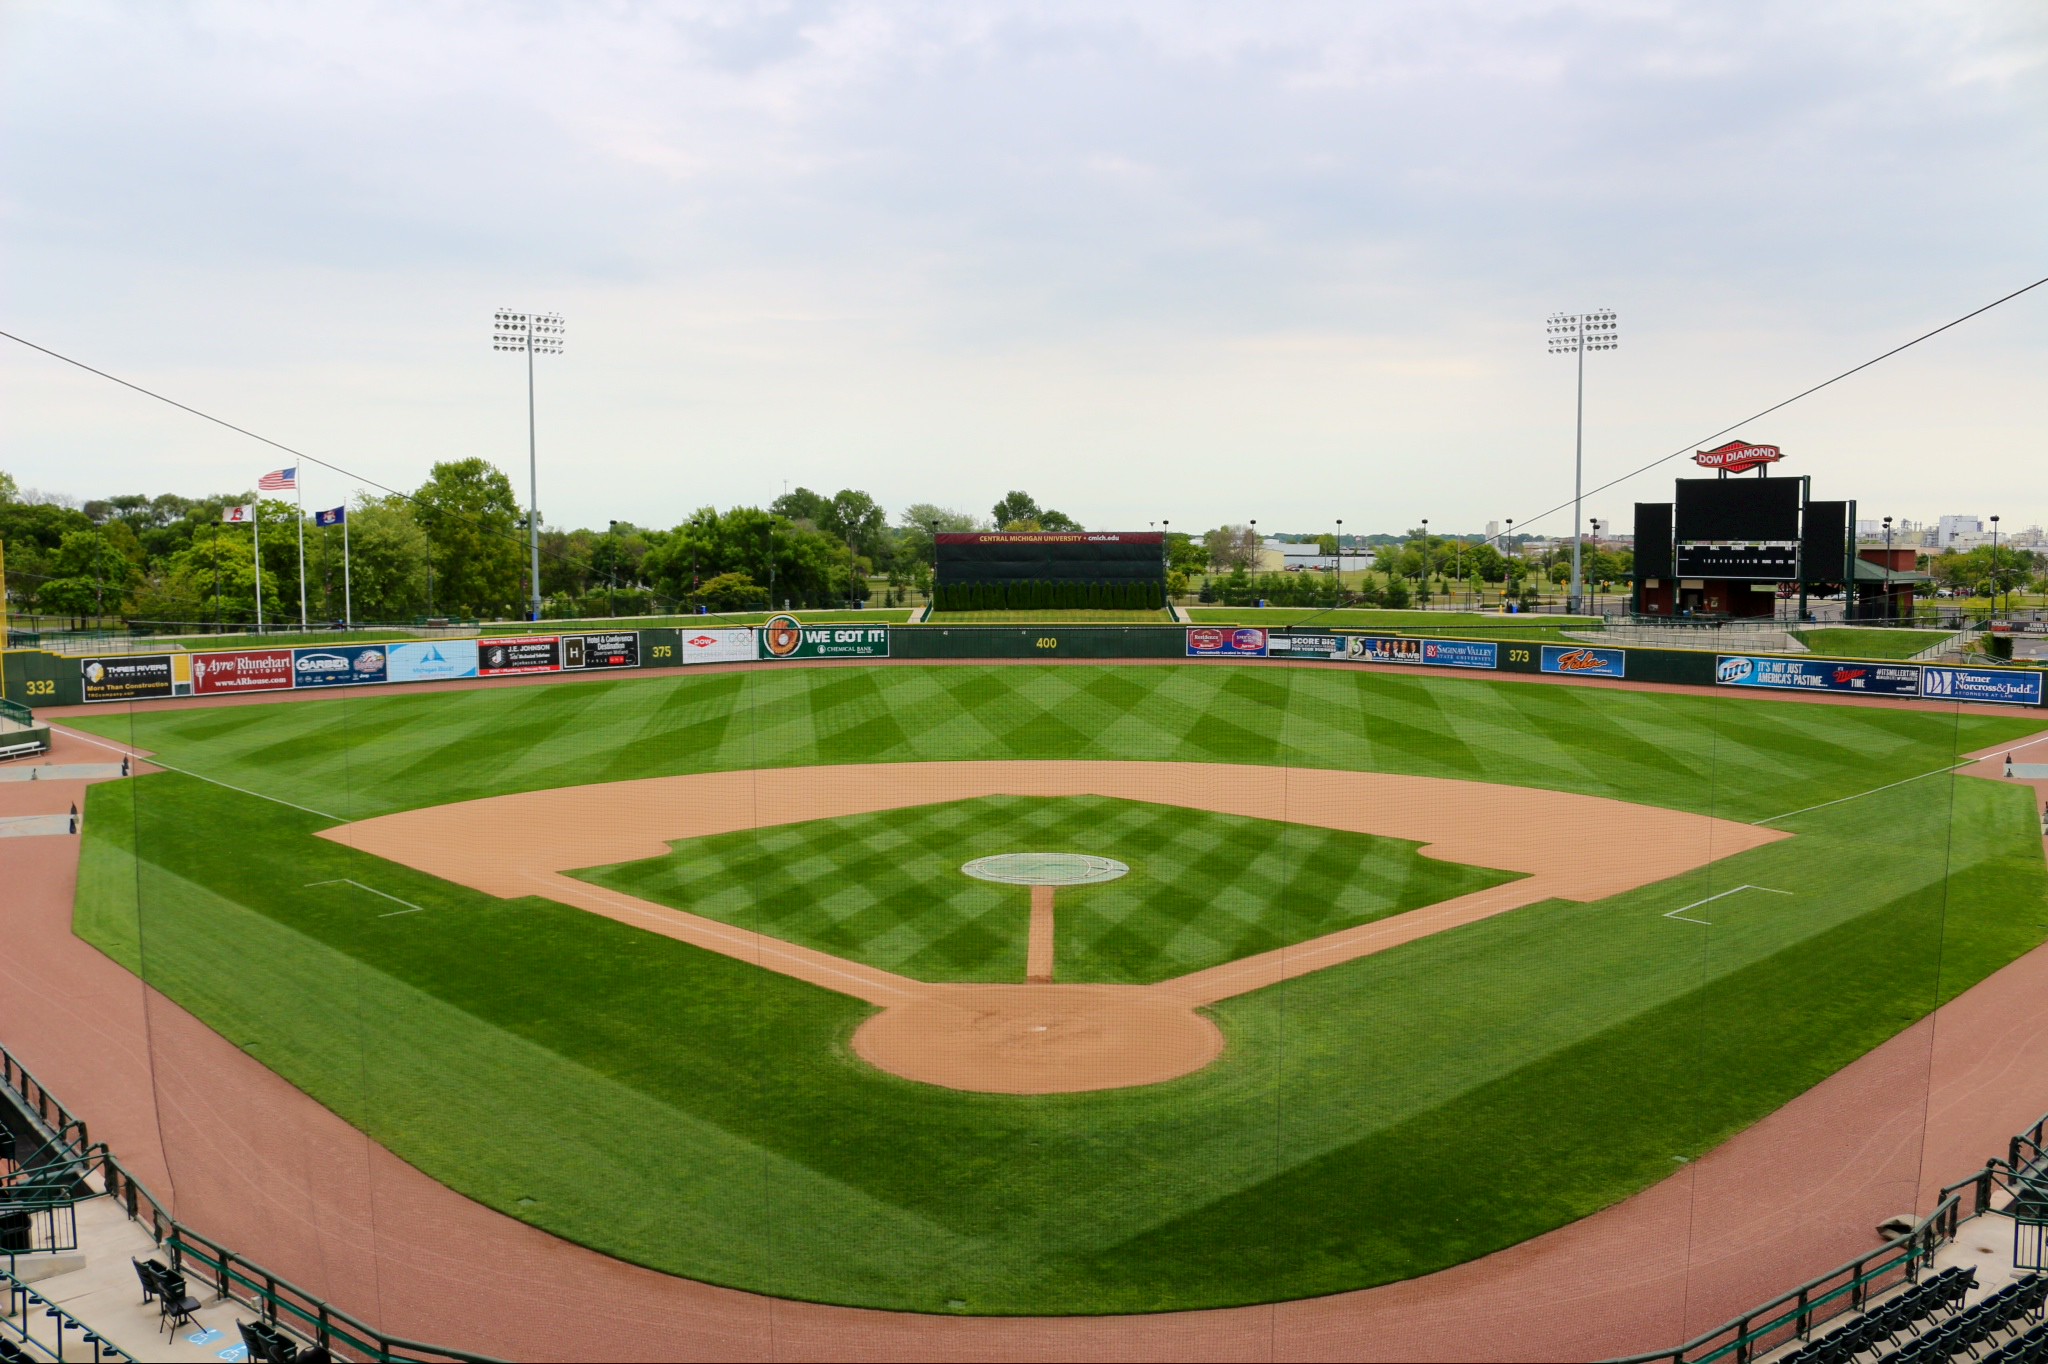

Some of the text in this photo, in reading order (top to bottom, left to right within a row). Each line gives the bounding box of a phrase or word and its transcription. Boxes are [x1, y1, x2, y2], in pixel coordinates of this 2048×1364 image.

[1698, 448, 1776, 464] DOW DIAMOND
[1088, 534, 1120, 542] cmich.edu
[587, 636, 600, 644] Hotel
[606, 635, 634, 643] Conference
[805, 630, 884, 643] WE GOT IT!
[1036, 638, 1056, 648] 400
[570, 647, 579, 658] H
[652, 646, 671, 657] 375
[1437, 645, 1493, 656] SAGINAW VALLEY
[1509, 650, 1529, 662] 373
[296, 658, 349, 671] GARBER
[1558, 649, 1608, 671] Fisher
[1757, 662, 1770, 672] IT'S
[1772, 663, 1785, 673] NOT
[1787, 664, 1803, 674] JUST
[1876, 668, 1919, 677] #ITSMILLERTIME
[1757, 672, 1828, 687] AMERICA'S PASTIME...
[1833, 669, 1867, 683] Miller
[1955, 673, 1991, 683] Warner
[26, 680, 56, 695] 332
[215, 677, 287, 687] www.ARhouse.com
[1851, 678, 1866, 688] TIME
